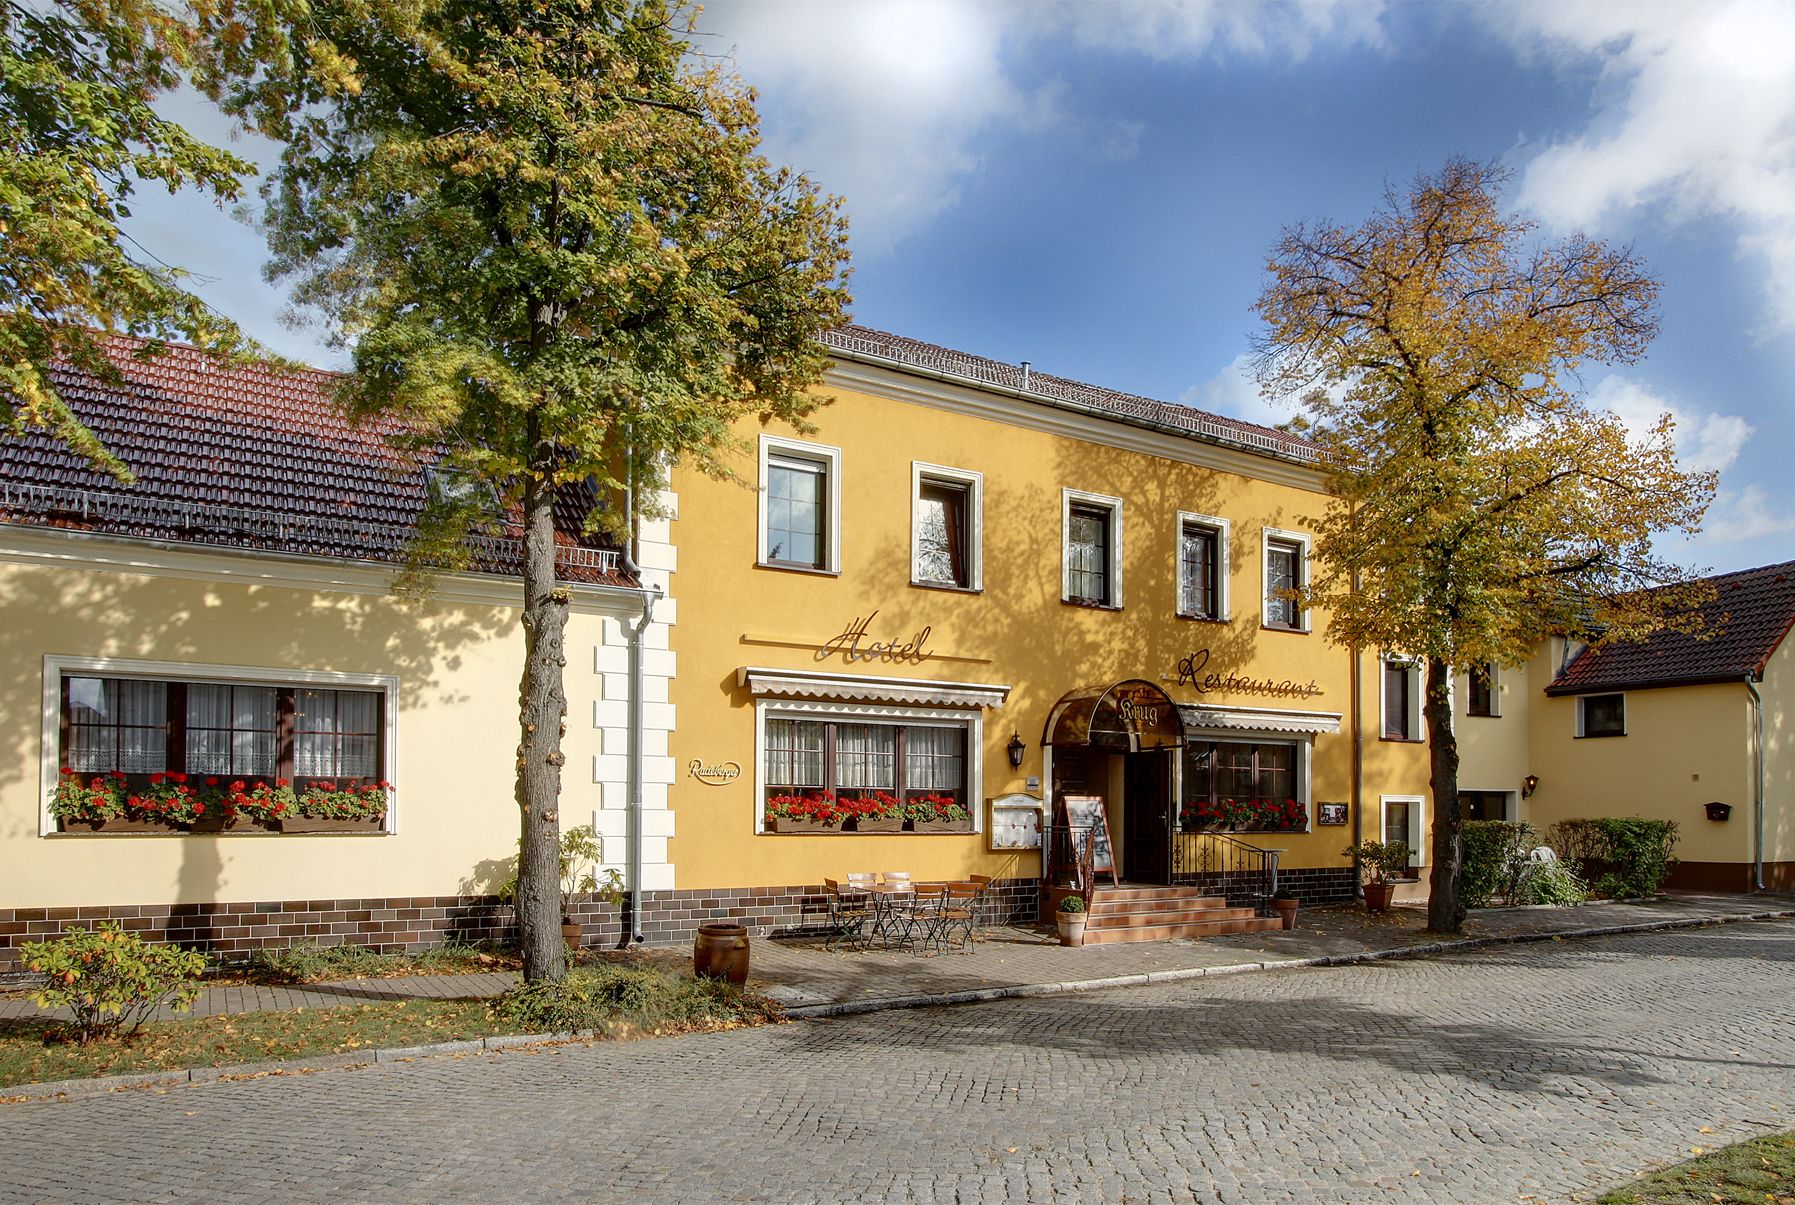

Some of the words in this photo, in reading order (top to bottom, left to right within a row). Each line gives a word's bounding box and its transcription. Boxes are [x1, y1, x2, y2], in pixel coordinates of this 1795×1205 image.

[819, 609, 934, 662] Hotel
[1178, 648, 1320, 697] Restaurant
[1119, 697, 1158, 727] Krug
